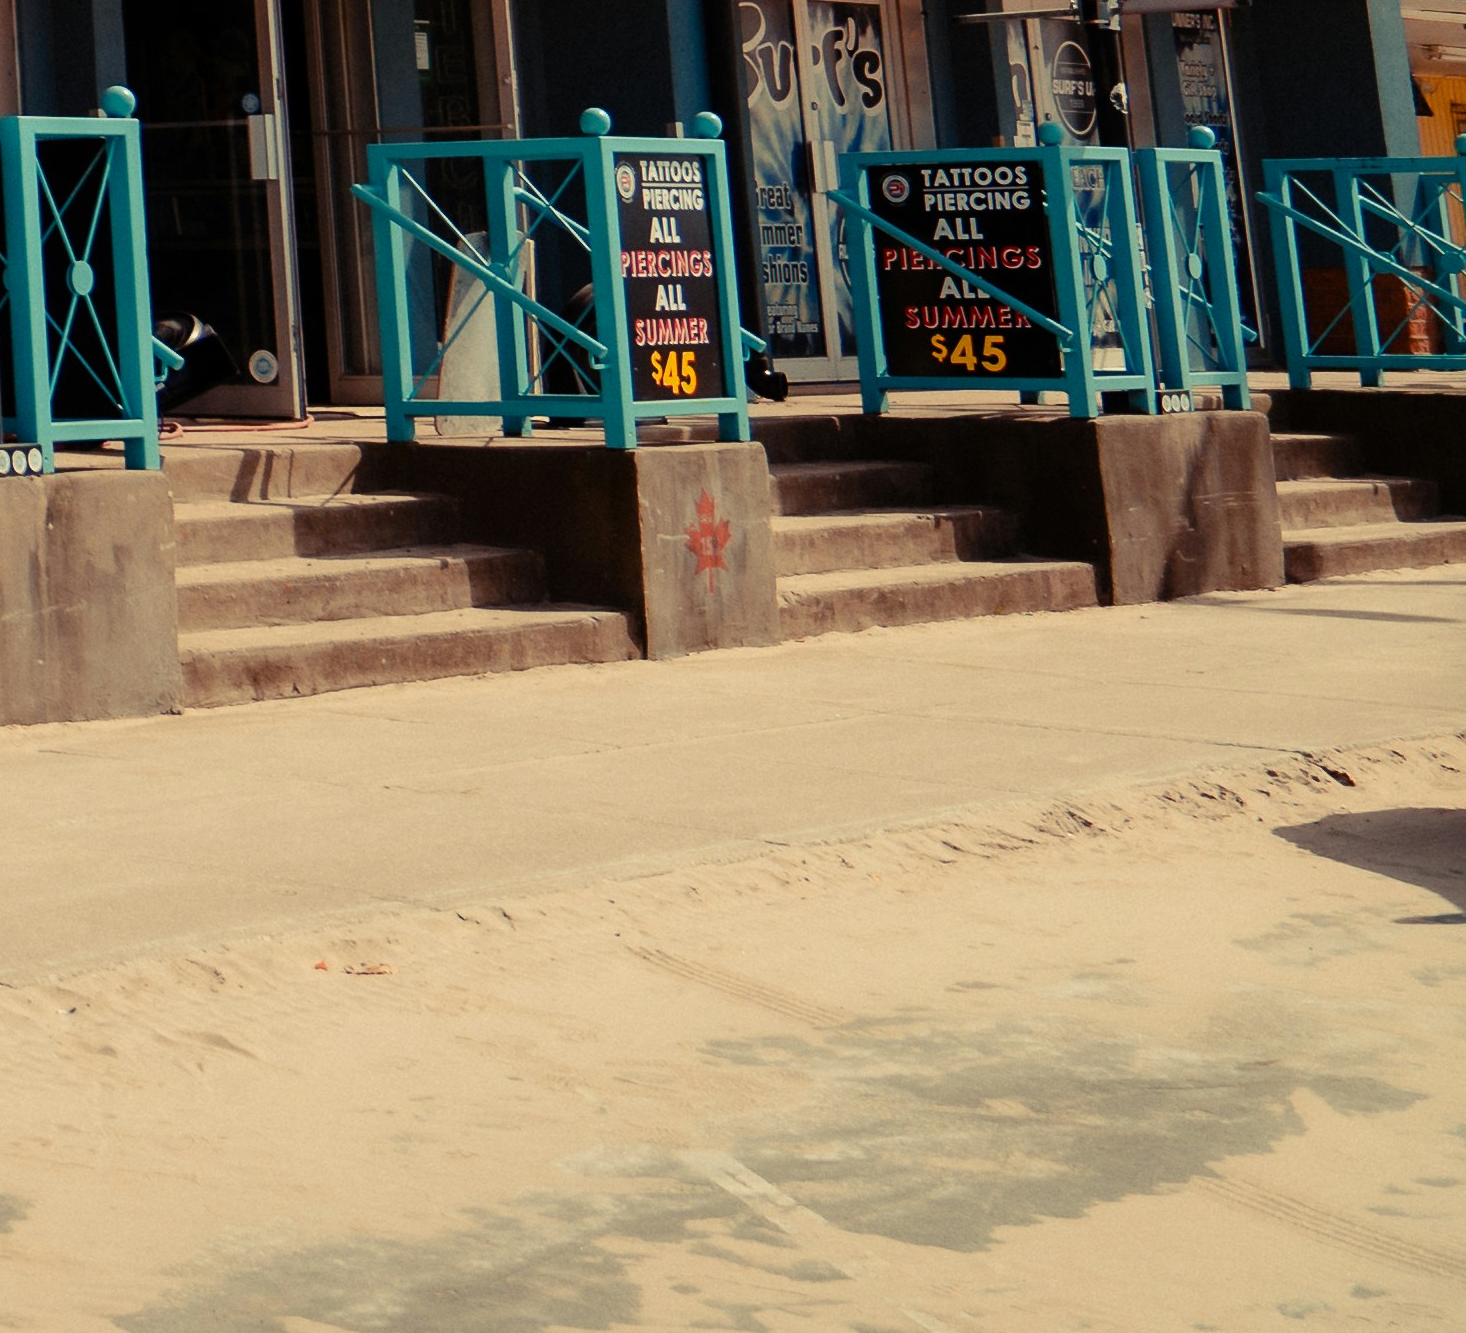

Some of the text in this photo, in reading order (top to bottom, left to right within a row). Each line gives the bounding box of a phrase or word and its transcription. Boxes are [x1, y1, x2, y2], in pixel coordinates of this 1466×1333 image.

[1052, 79, 1095, 97] SURF'S U
[639, 160, 701, 183] TATTOOS
[921, 166, 1028, 187] TATTOOS
[642, 188, 703, 211] PIERCING
[756, 181, 792, 210] reat
[924, 191, 1031, 212] PIERCING
[650, 217, 680, 244] ALL
[933, 218, 984, 241] ALL
[621, 250, 713, 278] PIERCINGS
[655, 284, 686, 312] ALL
[634, 317, 709, 347] SUMMER
[930, 334, 1007, 372] $45
[651, 350, 697, 395] $45
